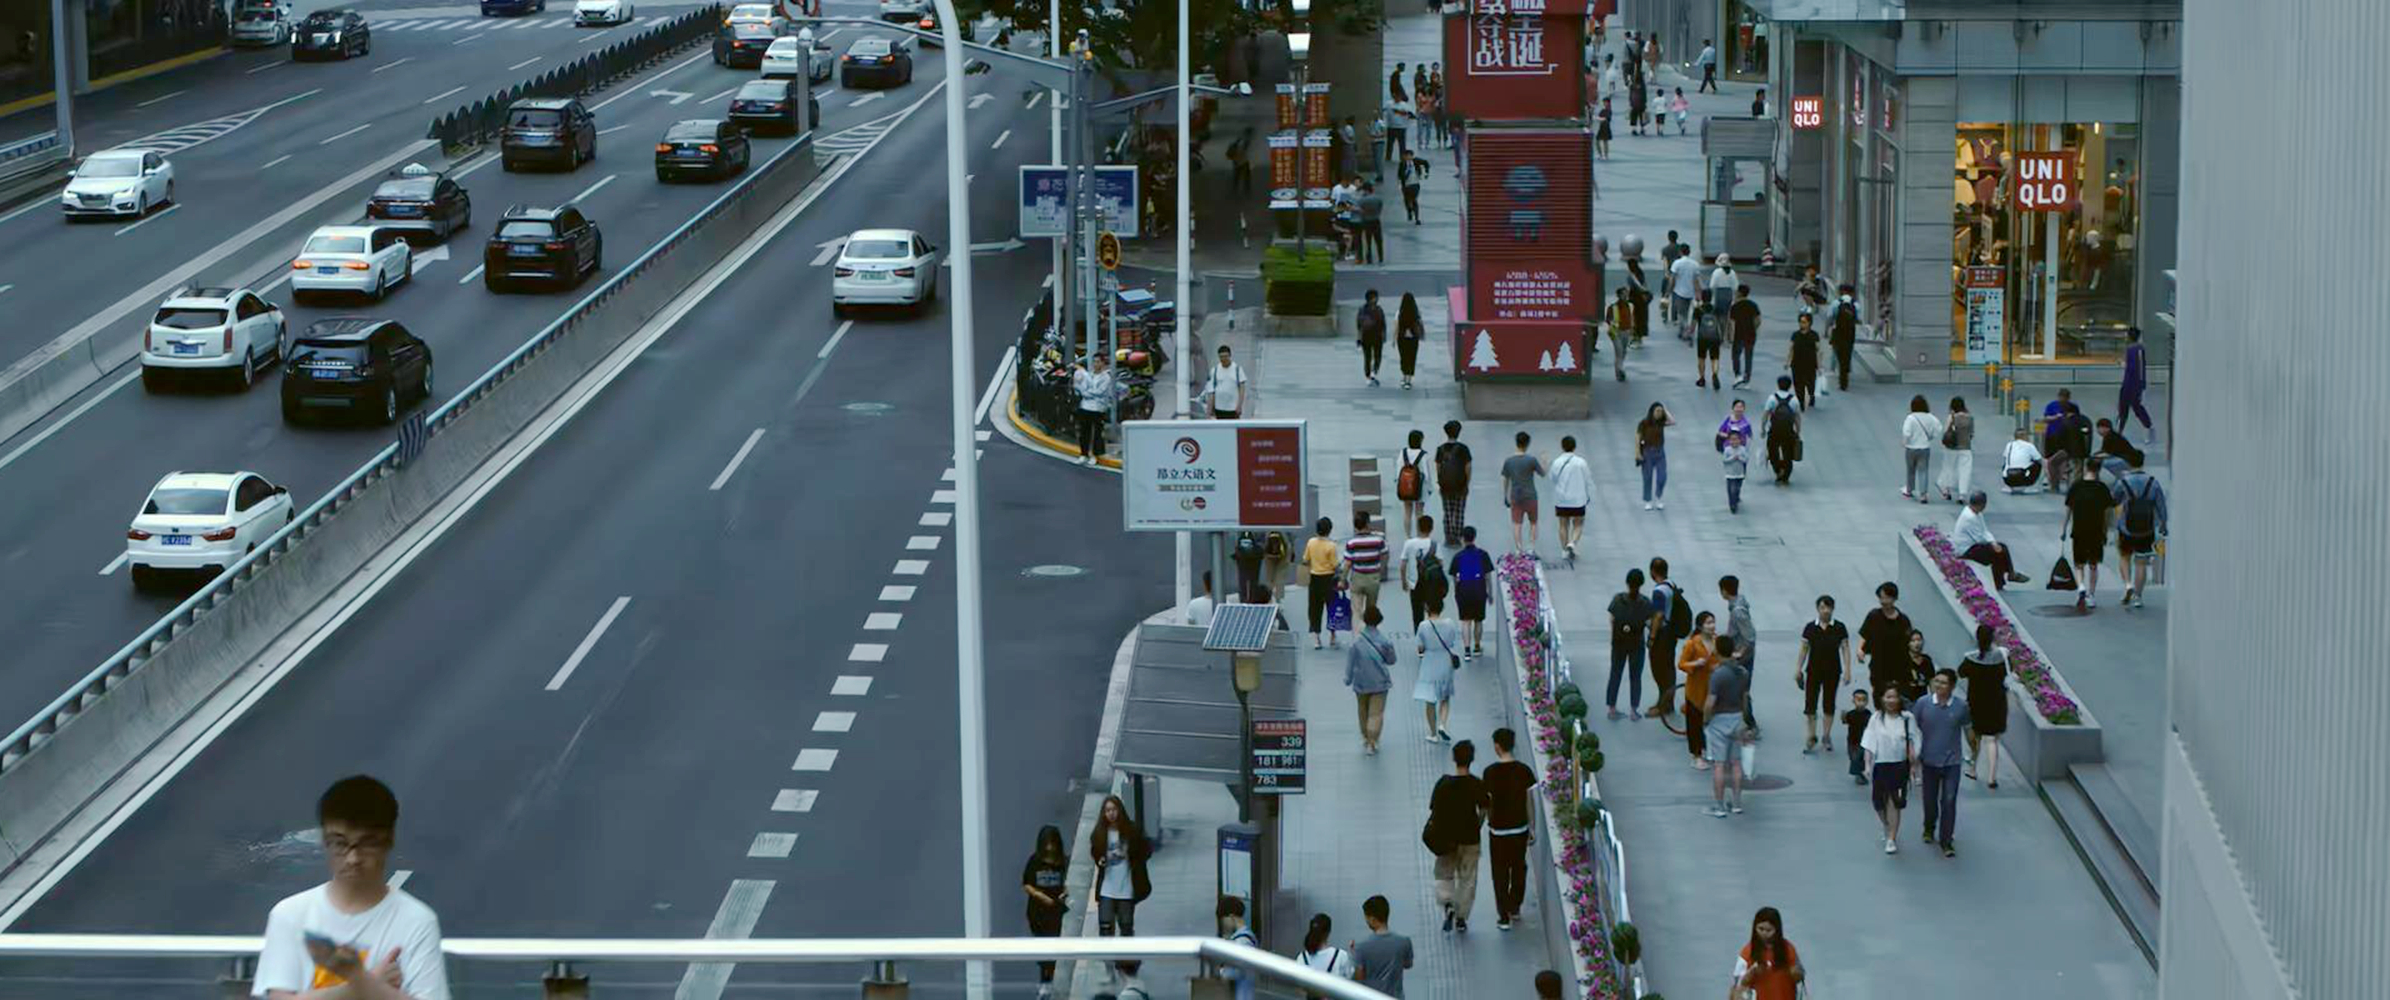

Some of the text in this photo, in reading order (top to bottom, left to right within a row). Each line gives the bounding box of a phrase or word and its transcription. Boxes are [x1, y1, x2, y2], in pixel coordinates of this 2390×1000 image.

[1794, 100, 1818, 112] UNI
[1793, 113, 1820, 127] QLO
[2020, 159, 2063, 180] UNI
[2019, 183, 2066, 207] QLO
[1280, 736, 1302, 747] 339
[1258, 755, 1276, 766] 181
[1256, 775, 1278, 785] 783
